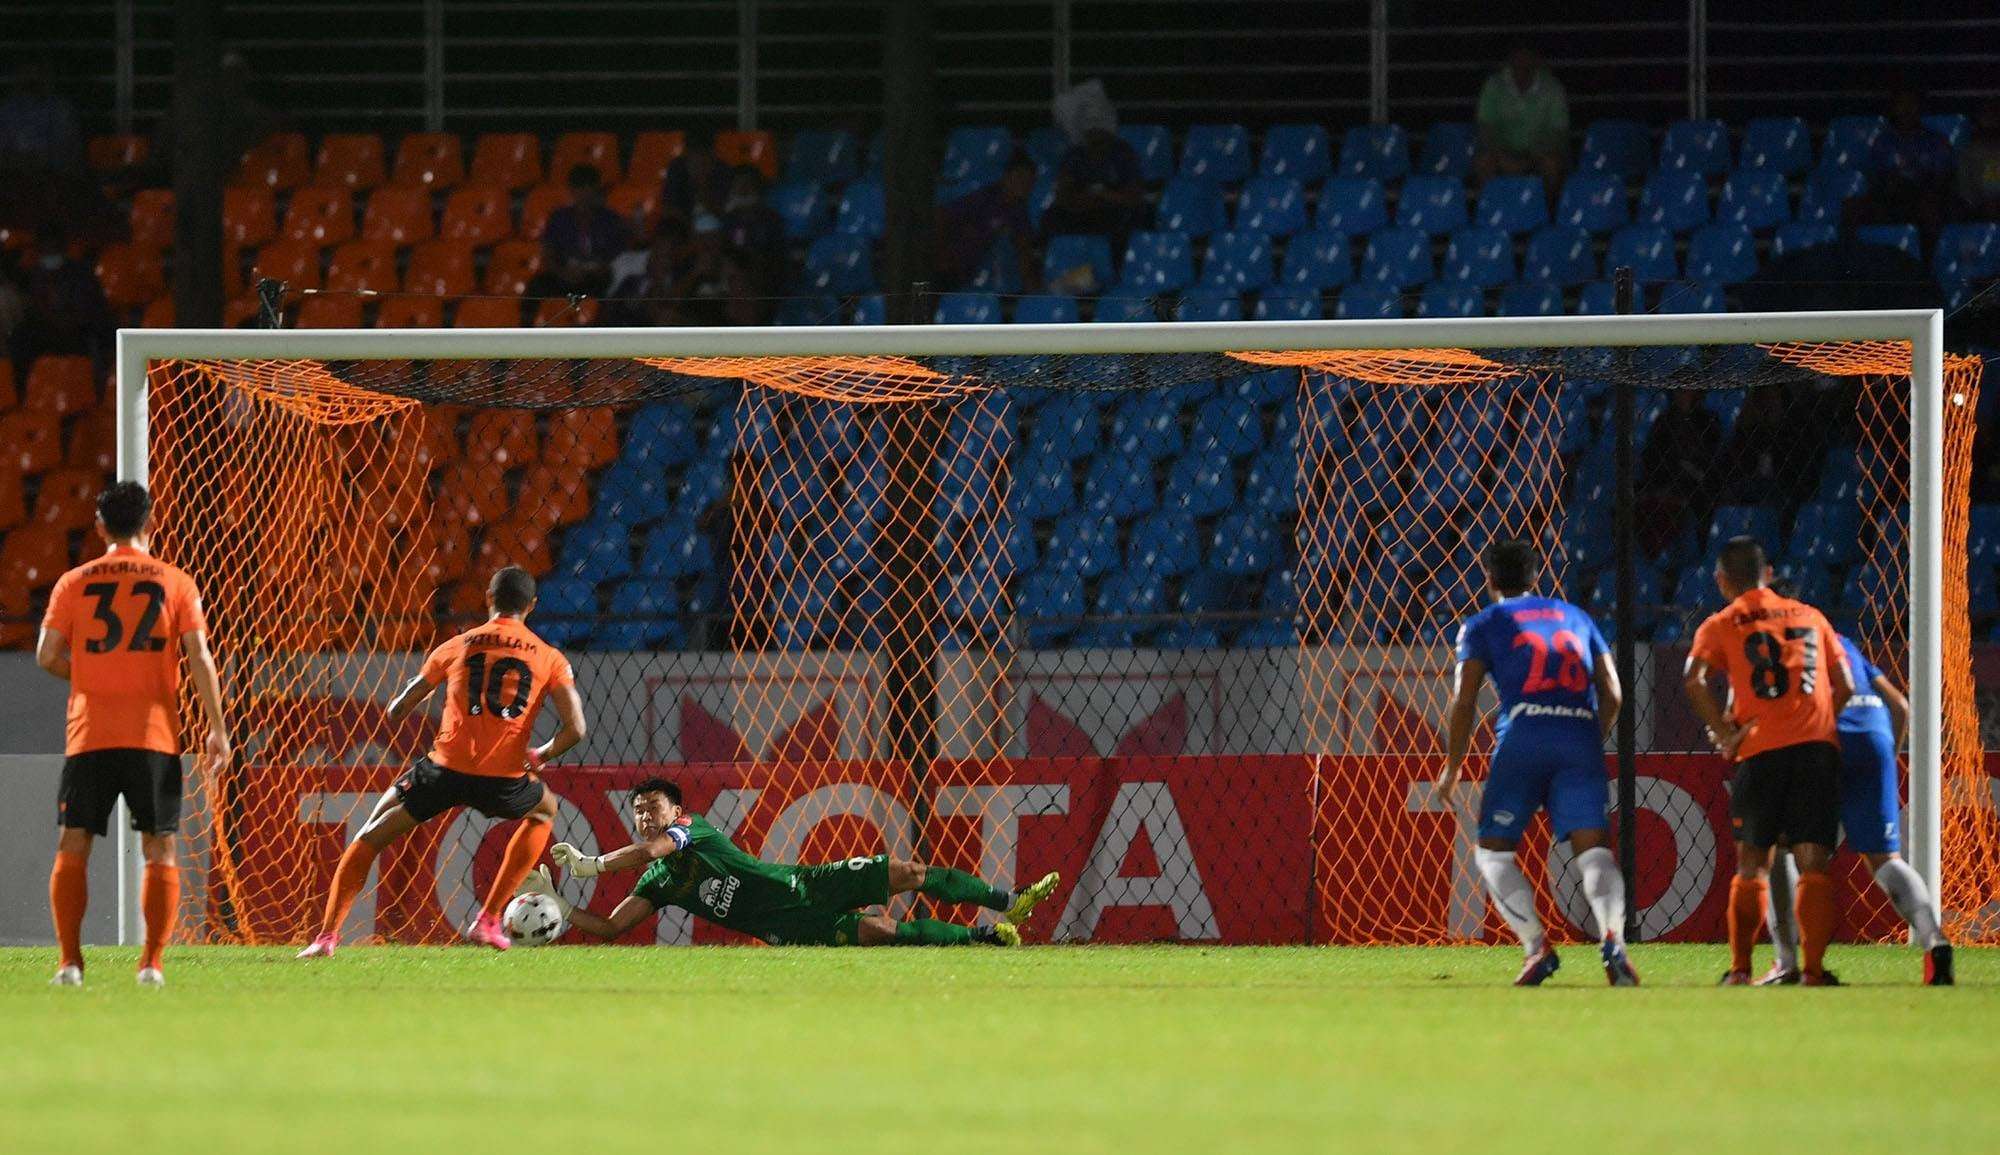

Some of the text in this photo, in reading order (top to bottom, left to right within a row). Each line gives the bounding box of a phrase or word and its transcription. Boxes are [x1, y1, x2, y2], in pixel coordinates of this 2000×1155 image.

[82, 580, 168, 654] 32
[465, 652, 533, 720] 10
[1511, 629, 1589, 694] 28
[1743, 627, 1819, 699] 87
[299, 780, 1221, 945] TOYOTA
[713, 874, 741, 918] Chang
